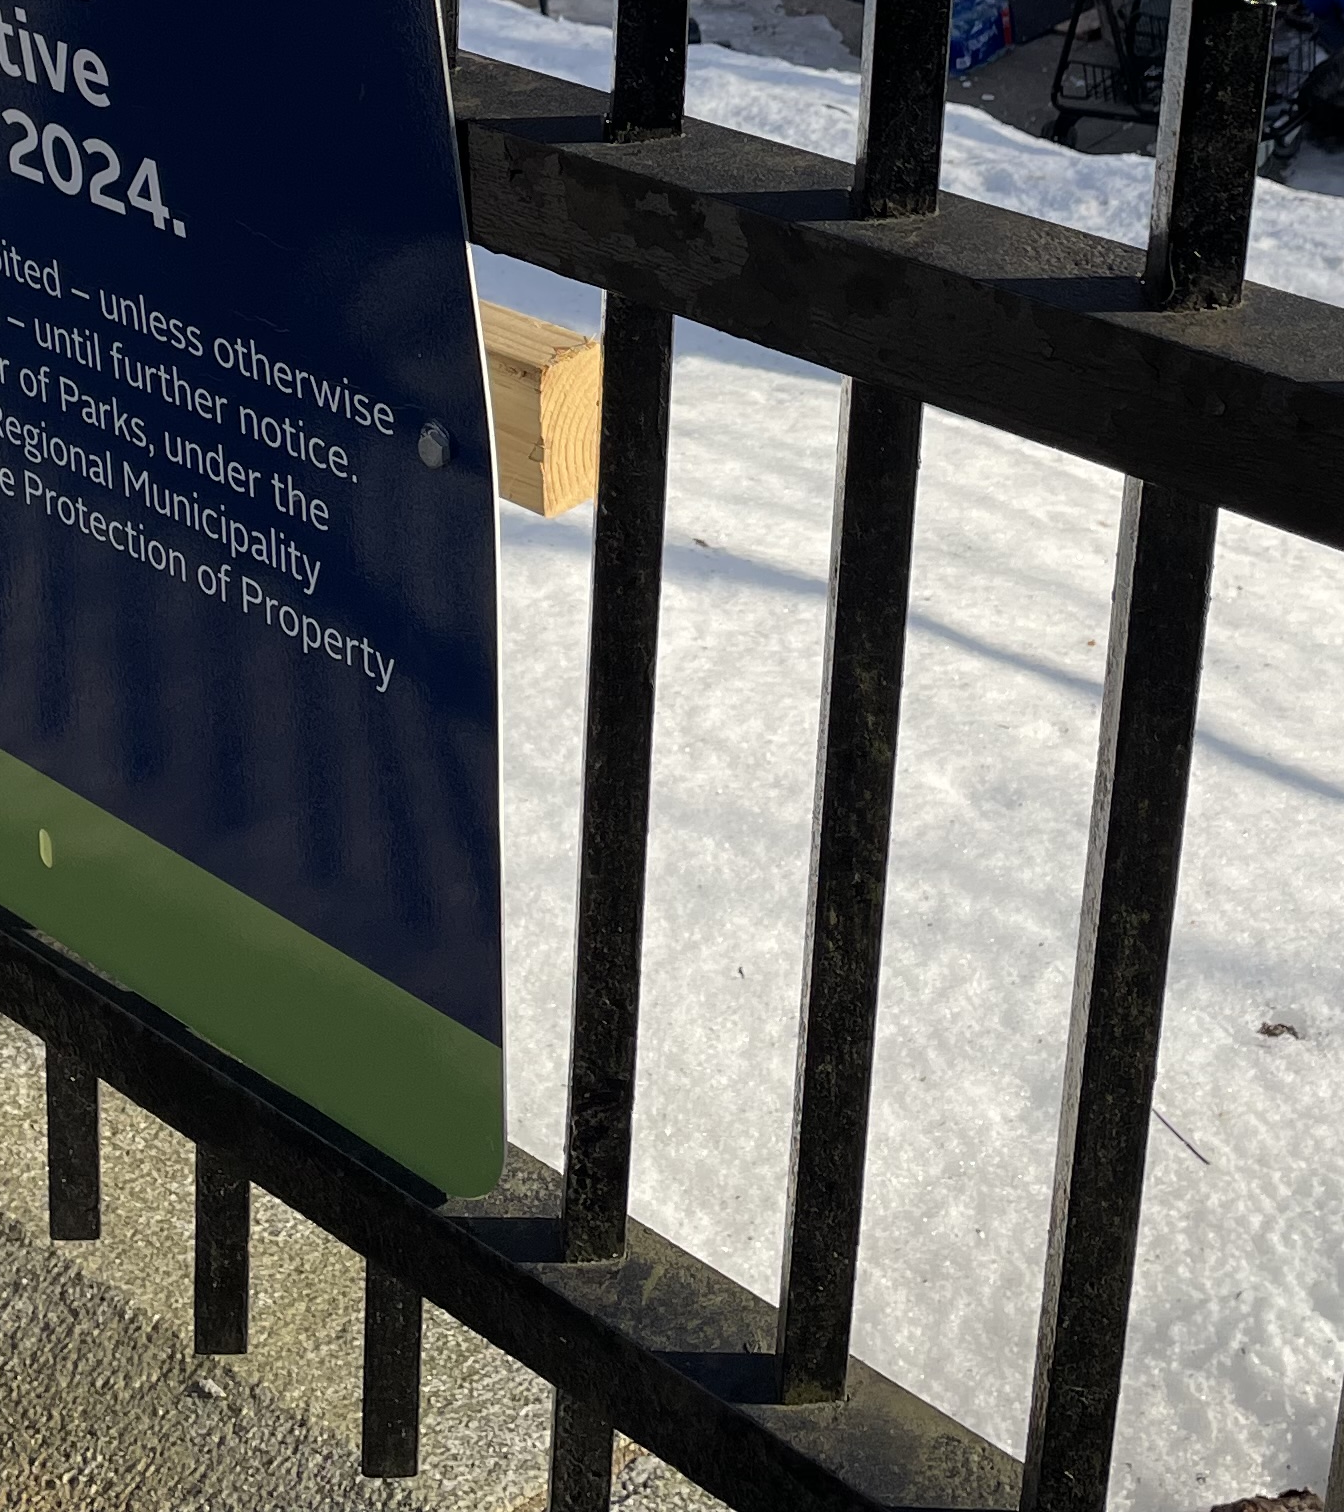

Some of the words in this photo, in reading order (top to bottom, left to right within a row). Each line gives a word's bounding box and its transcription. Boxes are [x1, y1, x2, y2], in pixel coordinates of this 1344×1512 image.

[2, 109, 186, 238] 2024.
[34, 318, 101, 371] until
[110, 342, 228, 424] further
[239, 406, 357, 483] notice.
[100, 289, 203, 356] unless
[214, 338, 394, 435] otherwise
[20, 366, 50, 403] of
[59, 376, 154, 457] Parks,
[165, 432, 261, 497] under
[271, 473, 329, 530] the
[24, 470, 186, 582] Protection
[198, 564, 231, 602] of
[242, 576, 394, 692] Property
[123, 461, 321, 595] Municipality
